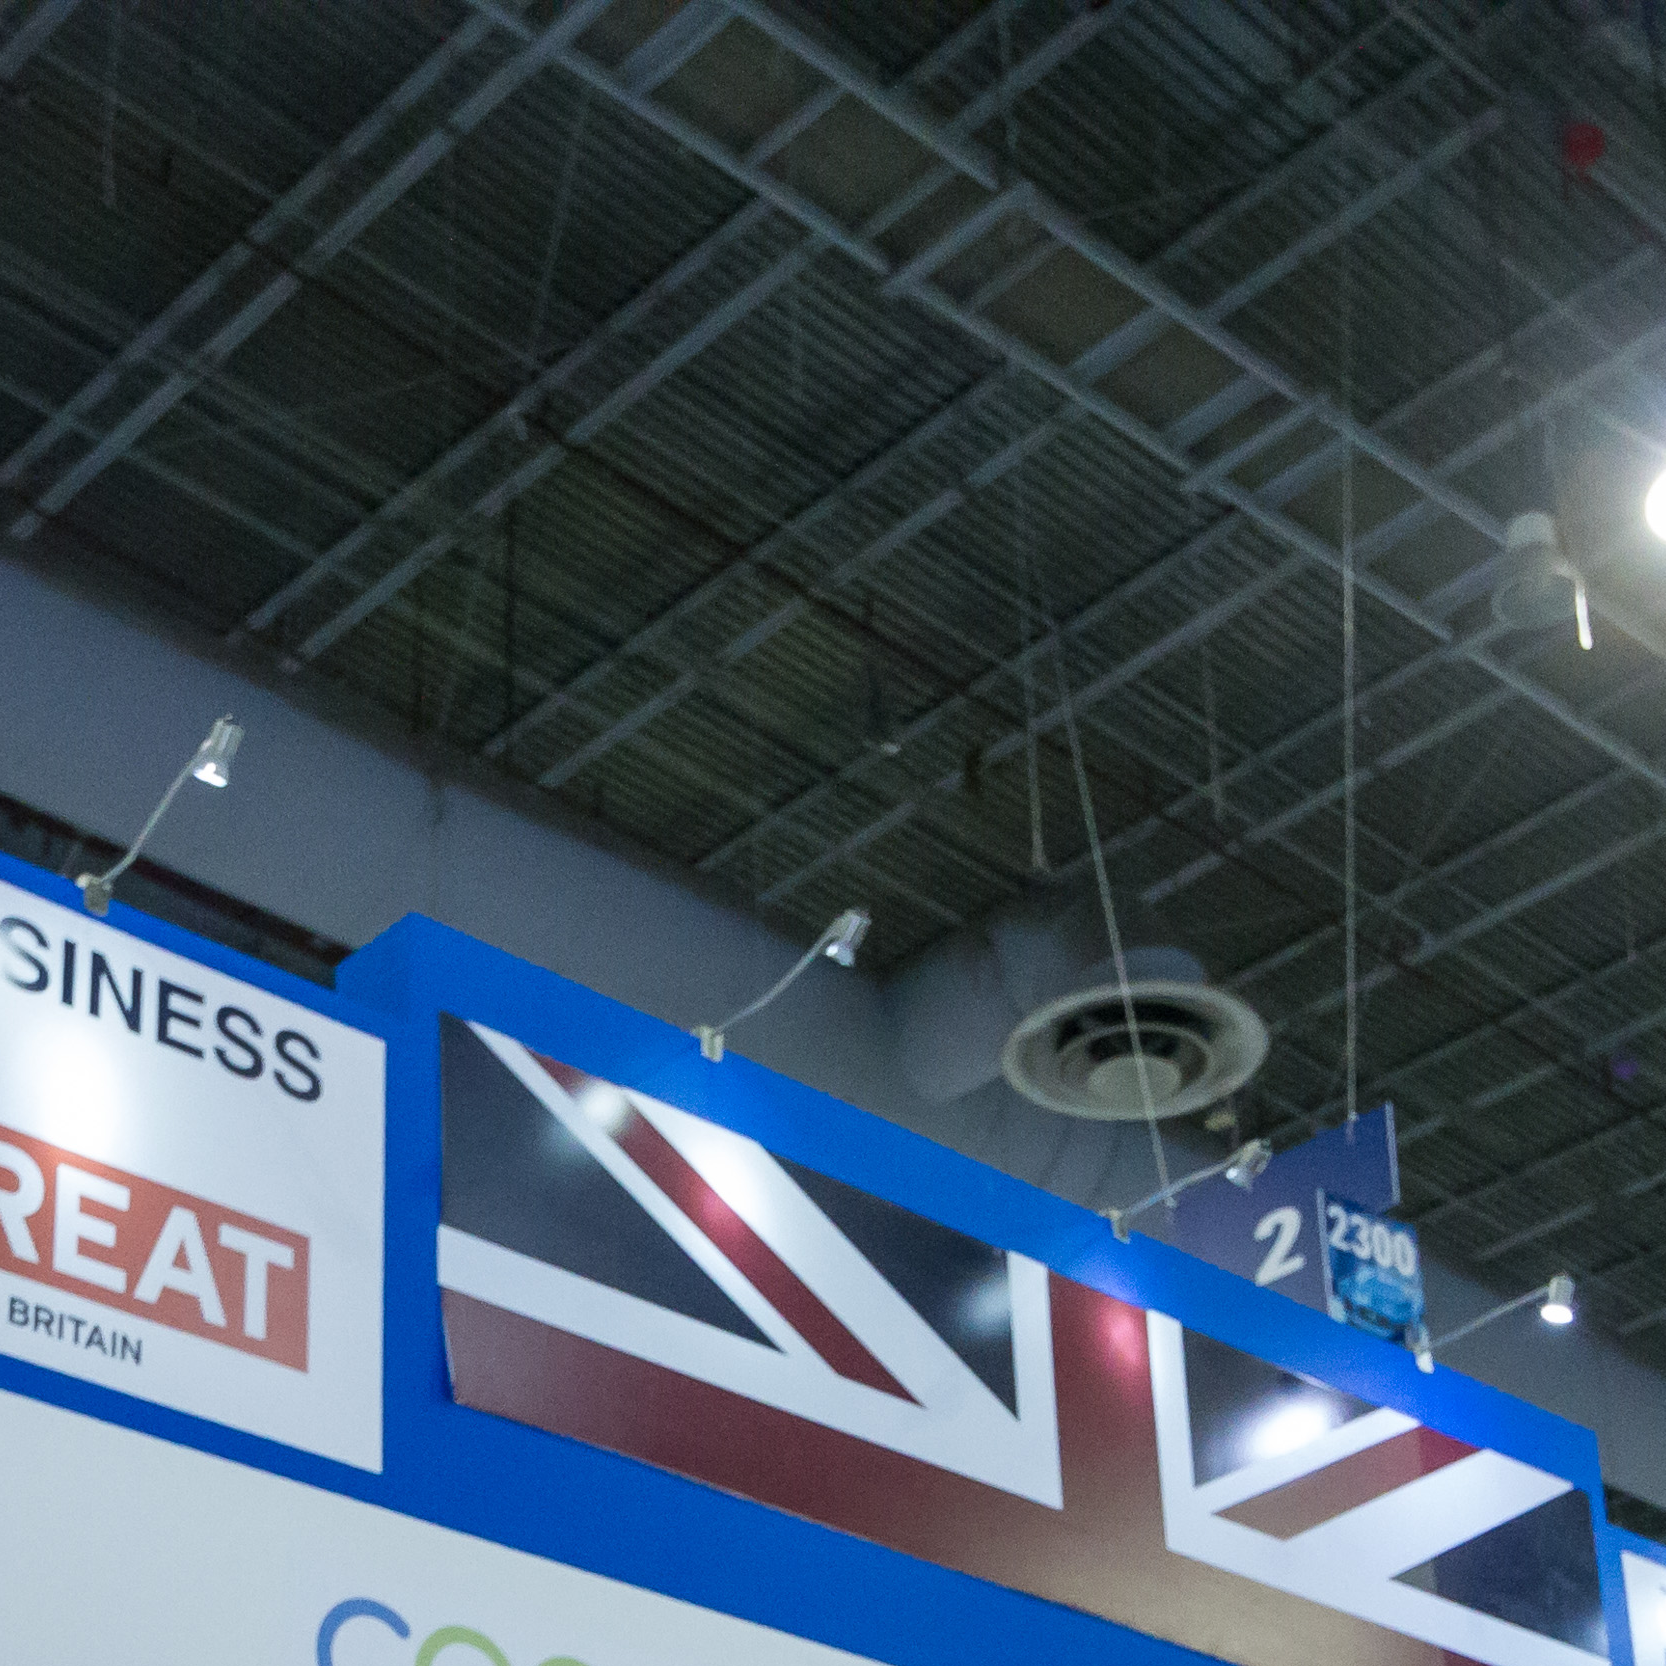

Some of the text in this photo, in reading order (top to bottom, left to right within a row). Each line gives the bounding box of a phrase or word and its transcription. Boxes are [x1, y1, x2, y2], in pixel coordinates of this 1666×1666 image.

[1253, 1205, 1305, 1287] 2
[1327, 1203, 1416, 1276] 2300
[6, 1296, 144, 1366] BRITAIN
